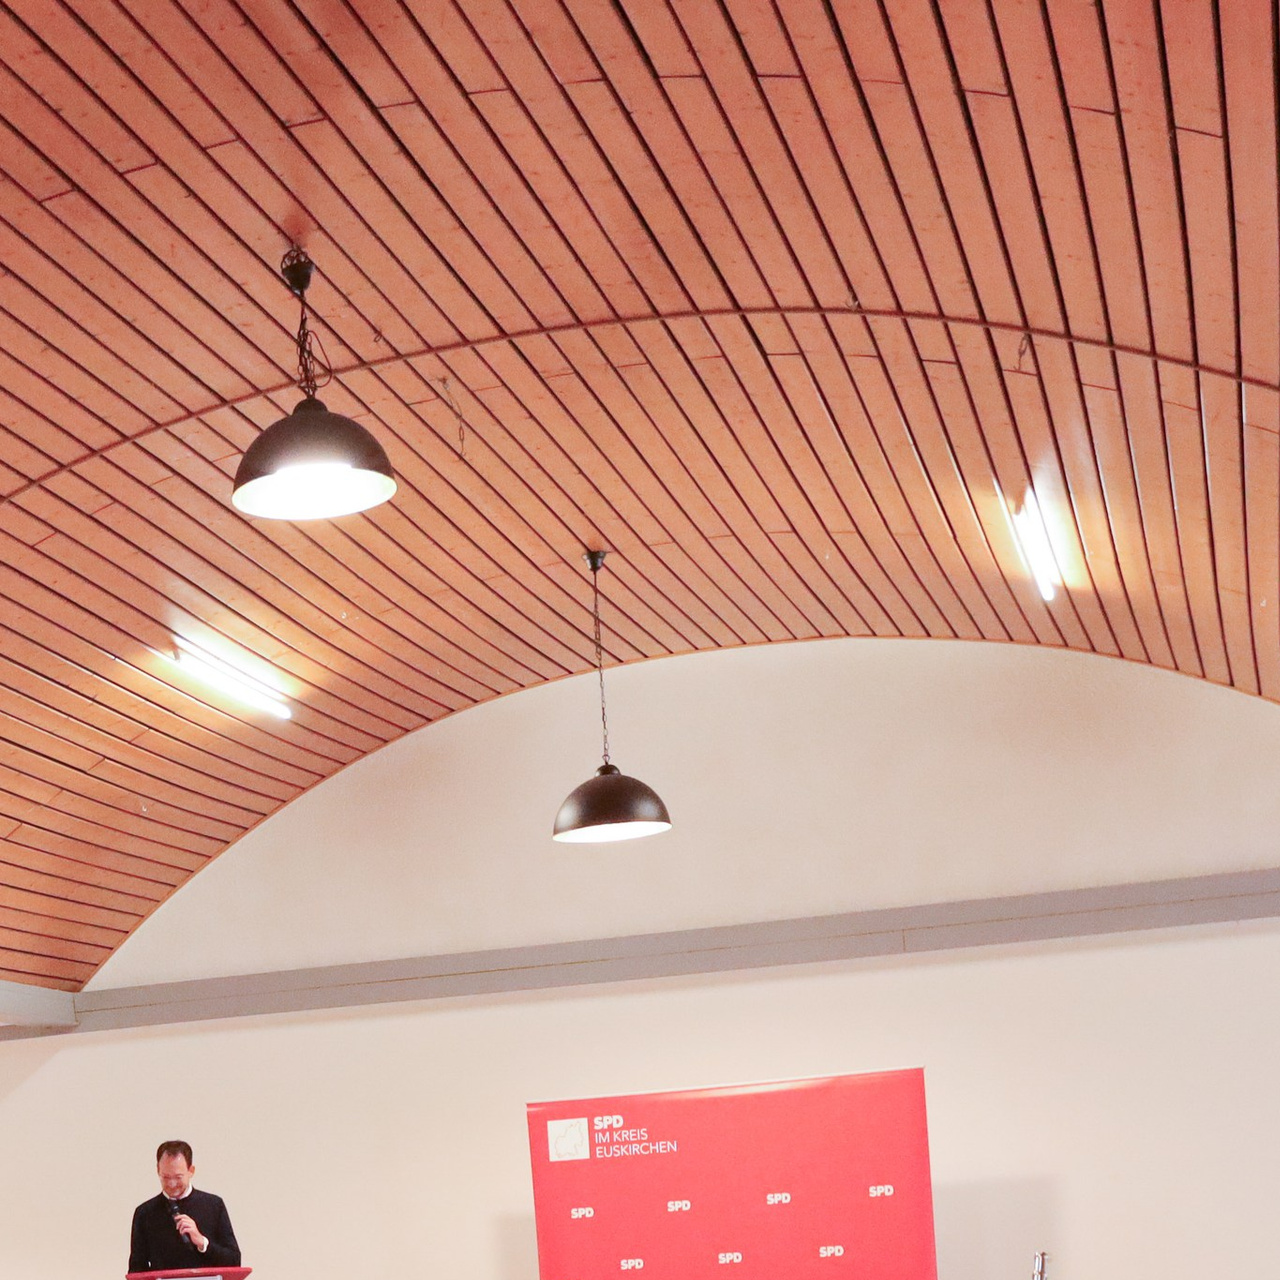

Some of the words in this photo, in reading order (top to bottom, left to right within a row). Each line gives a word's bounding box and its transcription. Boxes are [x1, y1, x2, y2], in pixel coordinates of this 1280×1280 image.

[594, 1115, 624, 1130] SPD
[595, 1131, 610, 1144] IM
[613, 1128, 648, 1142] KREIS
[596, 1140, 678, 1158] EUSKIRCHEN
[868, 1185, 894, 1197] SPD
[767, 1193, 791, 1204] SPD
[667, 1200, 691, 1212] SPD
[571, 1207, 594, 1219] SPD
[820, 1246, 844, 1257] SPD
[719, 1252, 742, 1264] SPD
[620, 1259, 644, 1270] SPD
